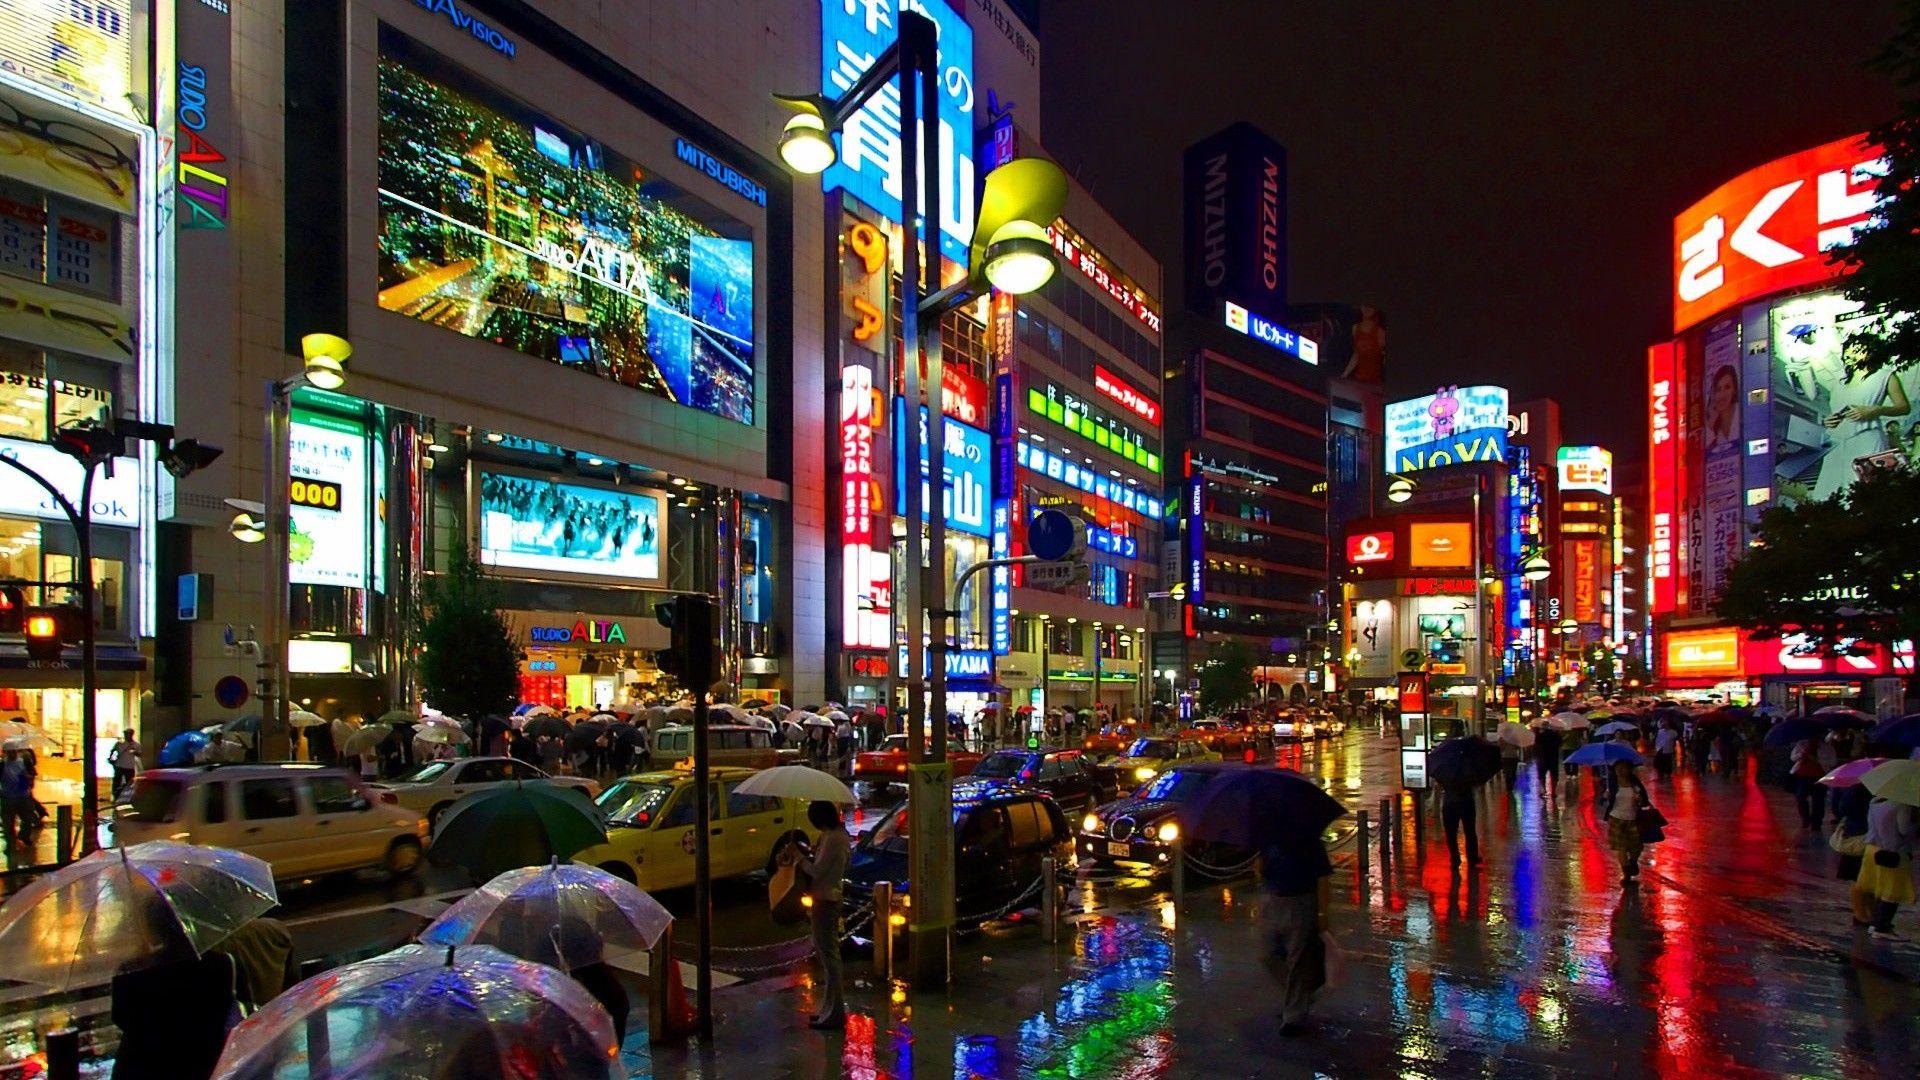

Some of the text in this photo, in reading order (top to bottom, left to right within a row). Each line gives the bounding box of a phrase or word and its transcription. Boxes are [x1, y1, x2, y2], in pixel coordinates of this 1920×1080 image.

[179, 60, 227, 230] STUDIO ALTA
[675, 137, 768, 207] MITSUBISHI
[1205, 153, 1227, 287] MIZUHO
[1263, 157, 1278, 290] MIZUHO
[576, 238, 656, 303] ALTA
[1402, 435, 1504, 472] NOVA
[531, 620, 626, 644] STUDIO ALTA
[1406, 652, 1418, 667] 2
